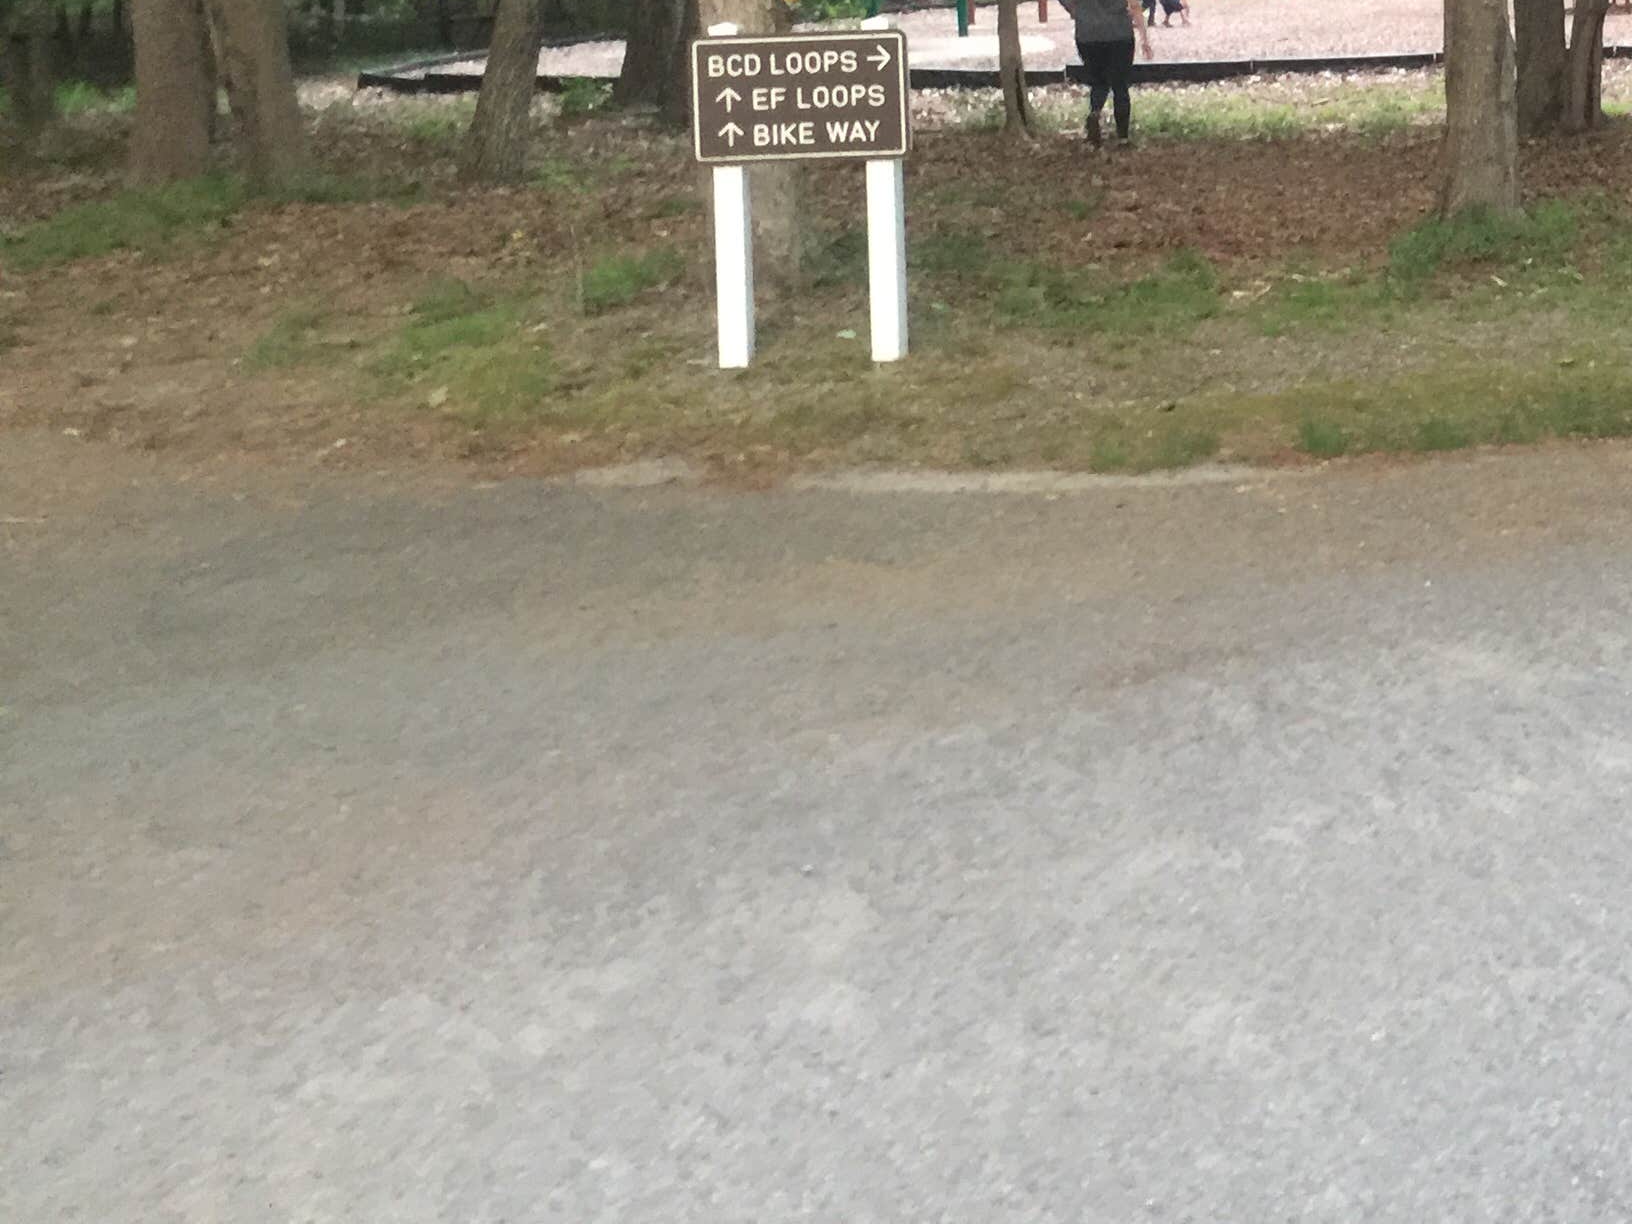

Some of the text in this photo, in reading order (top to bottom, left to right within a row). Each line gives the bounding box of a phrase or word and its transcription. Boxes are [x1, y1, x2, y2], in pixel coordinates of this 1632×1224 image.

[708, 50, 858, 78] BCD LOOPS
[752, 84, 886, 111] EF LOOPS
[753, 120, 881, 147] BIKE WAY
